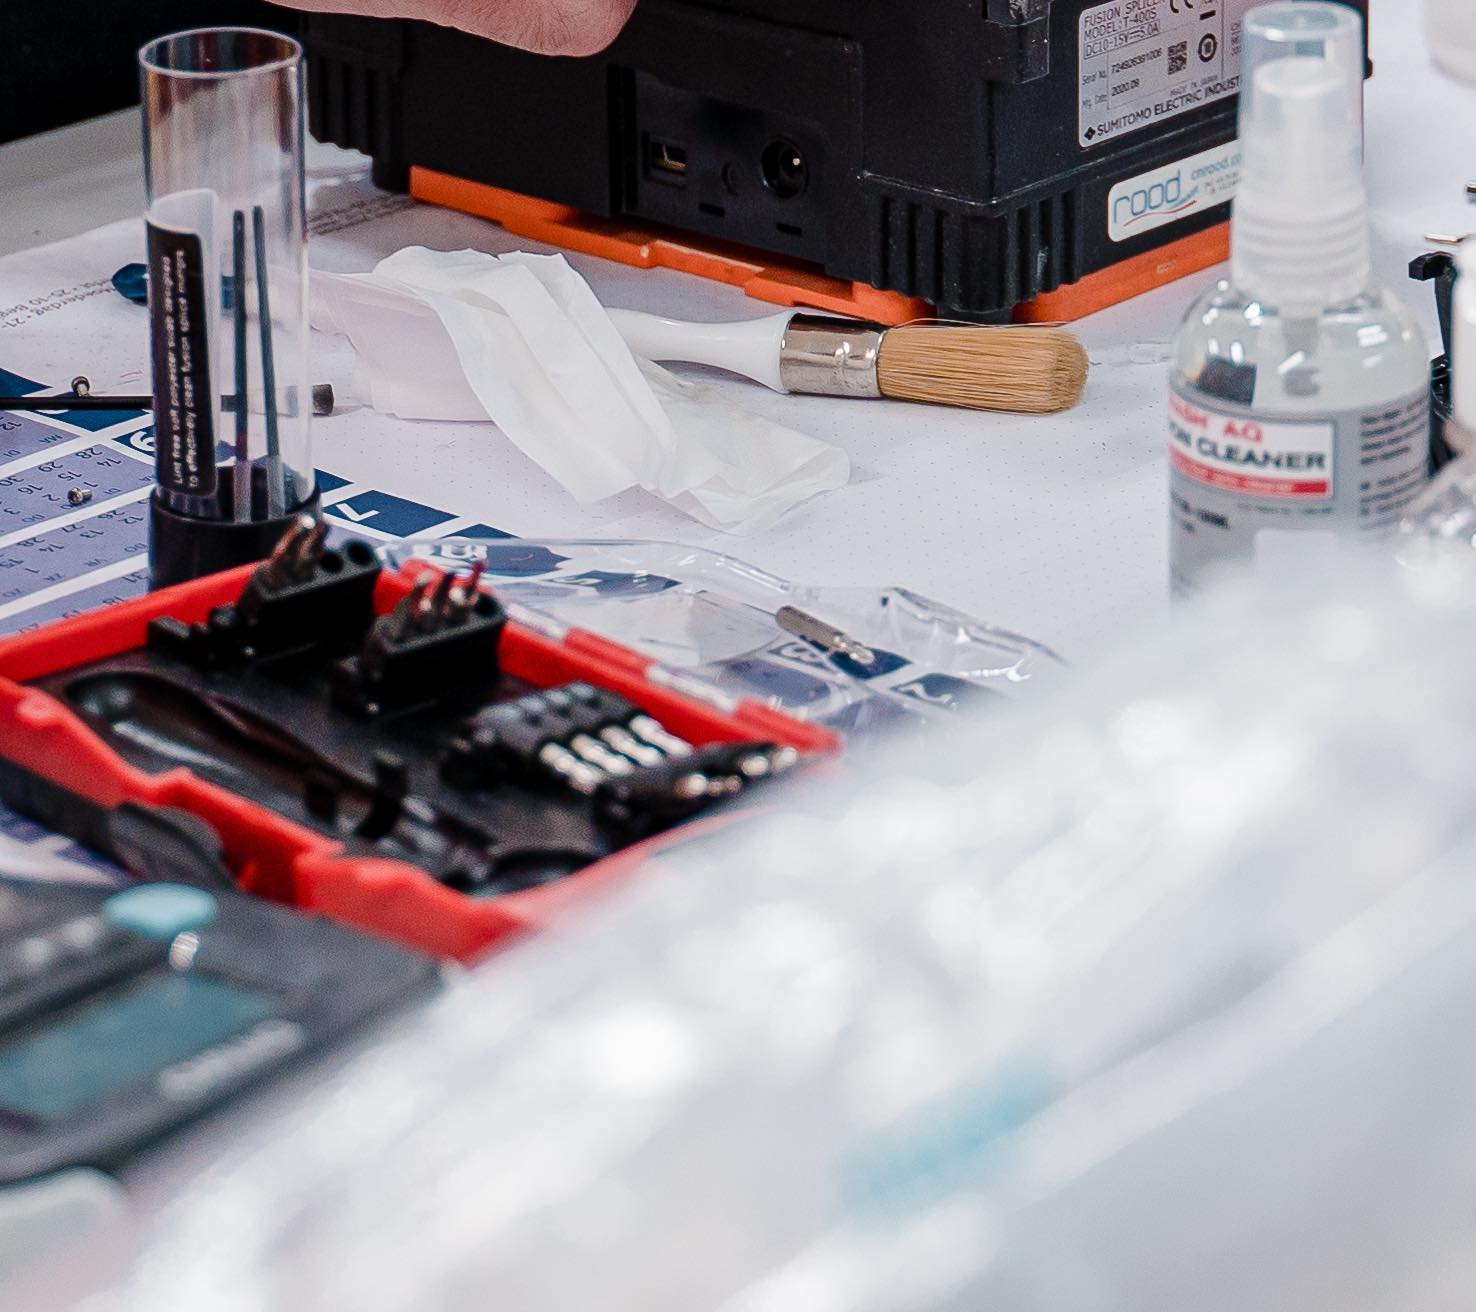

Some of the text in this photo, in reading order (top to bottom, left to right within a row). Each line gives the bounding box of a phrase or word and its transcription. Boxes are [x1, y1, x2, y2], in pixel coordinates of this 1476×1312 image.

[1084, 6, 1121, 29] FUSION
[1096, 106, 1152, 137] SUMITOMO
[1153, 88, 1203, 117] ELECTRIC
[1113, 168, 1181, 224] rood
[74, 448, 103, 460] 28
[171, 434, 181, 459] free
[1196, 436, 1326, 470] CLEANER
[17, 457, 122, 495] 14 15 16
[37, 461, 64, 473] 29
[42, 494, 60, 502] 2
[335, 503, 381, 522] 7
[16, 509, 125, 548] 26 27 28
[38, 544, 65, 553] 14
